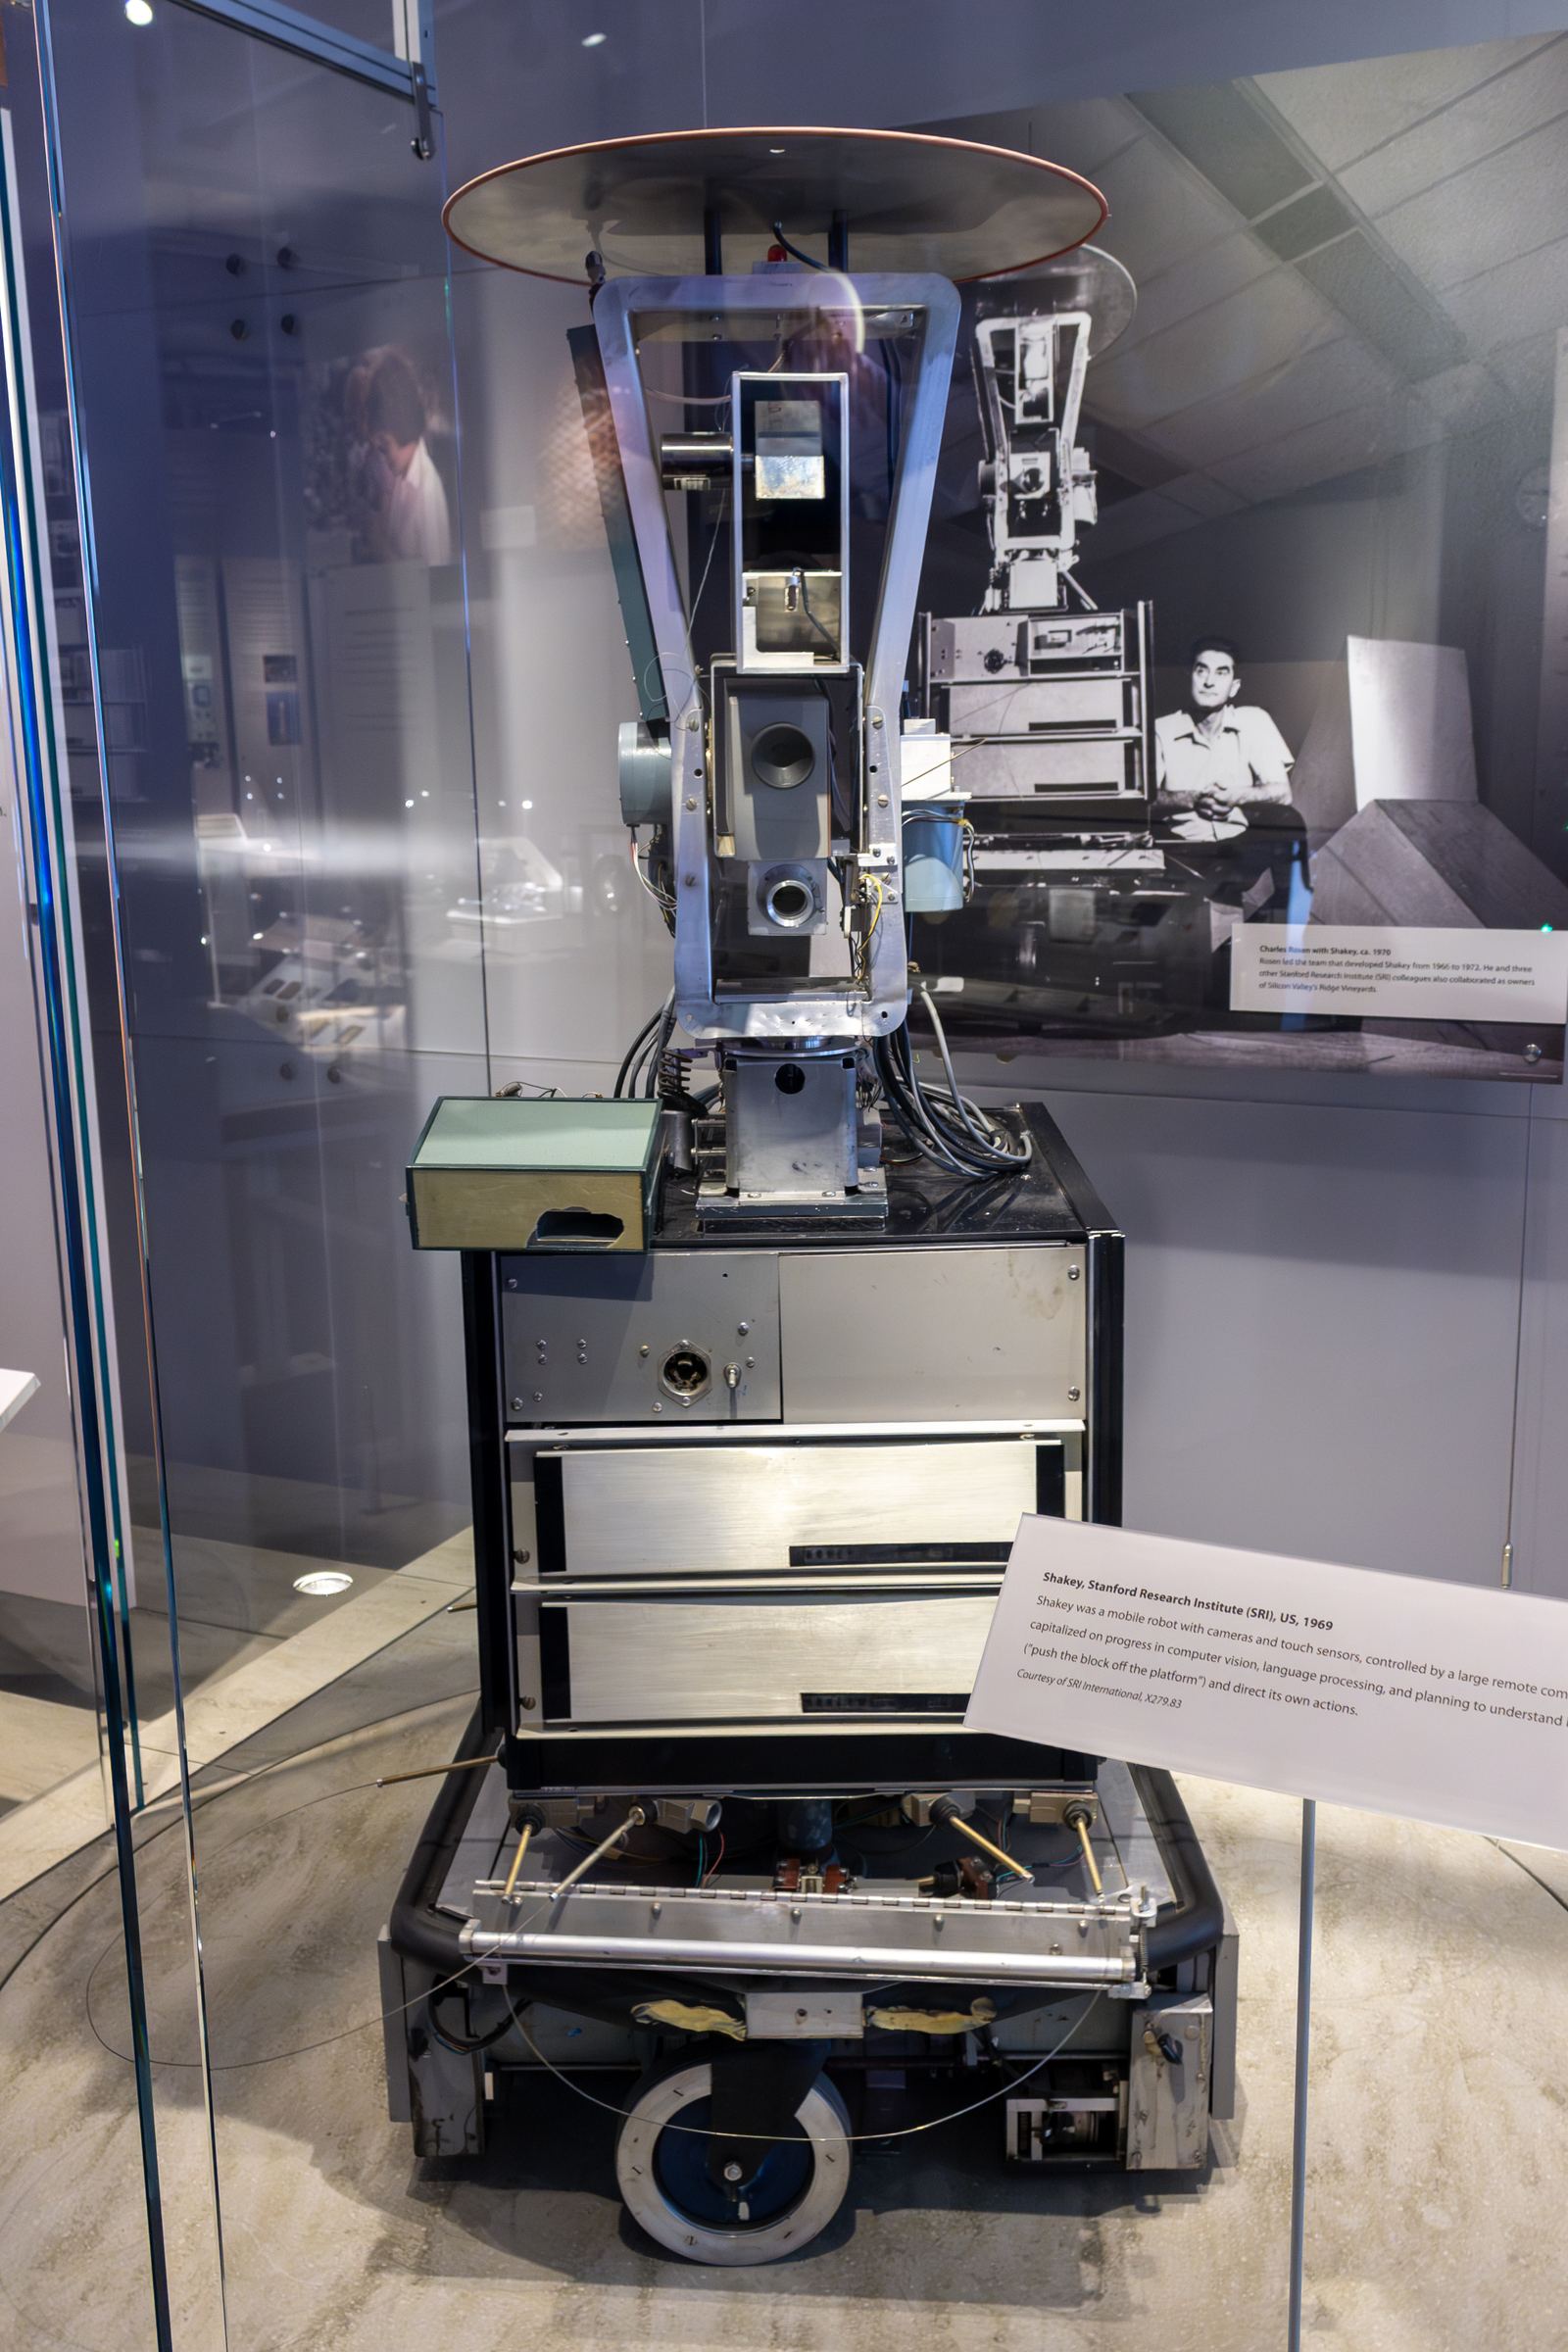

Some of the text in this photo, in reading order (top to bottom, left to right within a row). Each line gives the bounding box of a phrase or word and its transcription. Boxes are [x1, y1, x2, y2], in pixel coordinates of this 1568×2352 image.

[1319, 984, 1340, 993] Ridge
[1344, 960, 1383, 969] developed
[1385, 961, 1410, 970] Shakey
[1043, 1572, 1334, 1631] Shakey, Stanford Research Institute (SRI), US, 1969
[1030, 1621, 1087, 1639] capitalized
[1089, 1632, 1102, 1642] on
[1104, 1635, 1152, 1651] progress
[1154, 1642, 1164, 1652] in
[1167, 1646, 1223, 1663] computer
[1224, 1655, 1259, 1672] vision,
[1262, 1661, 1317, 1682] language
[1319, 1673, 1386, 1695] processing,
[1389, 1686, 1413, 1698] and
[1415, 1690, 1470, 1711] planning
[1473, 1701, 1487, 1712] to
[1490, 1706, 1563, 1727] understand
[1036, 1594, 1568, 1699] Shakey was a mobile robot with cameras and touch sensors, controlled by a large remote com
[1016, 1668, 1183, 1709] Courtesy of SRI International, X279.83
[1060, 1650, 1078, 1662] the
[1080, 1653, 1109, 1669] block
[1111, 1661, 1129, 1672] off
[1129, 1664, 1149, 1676] the
[1208, 1681, 1231, 1691] and
[1233, 1683, 1266, 1698] direct
[1268, 1690, 1282, 1701] its
[1284, 1693, 1310, 1706] own
[1312, 1697, 1358, 1716] actions.
